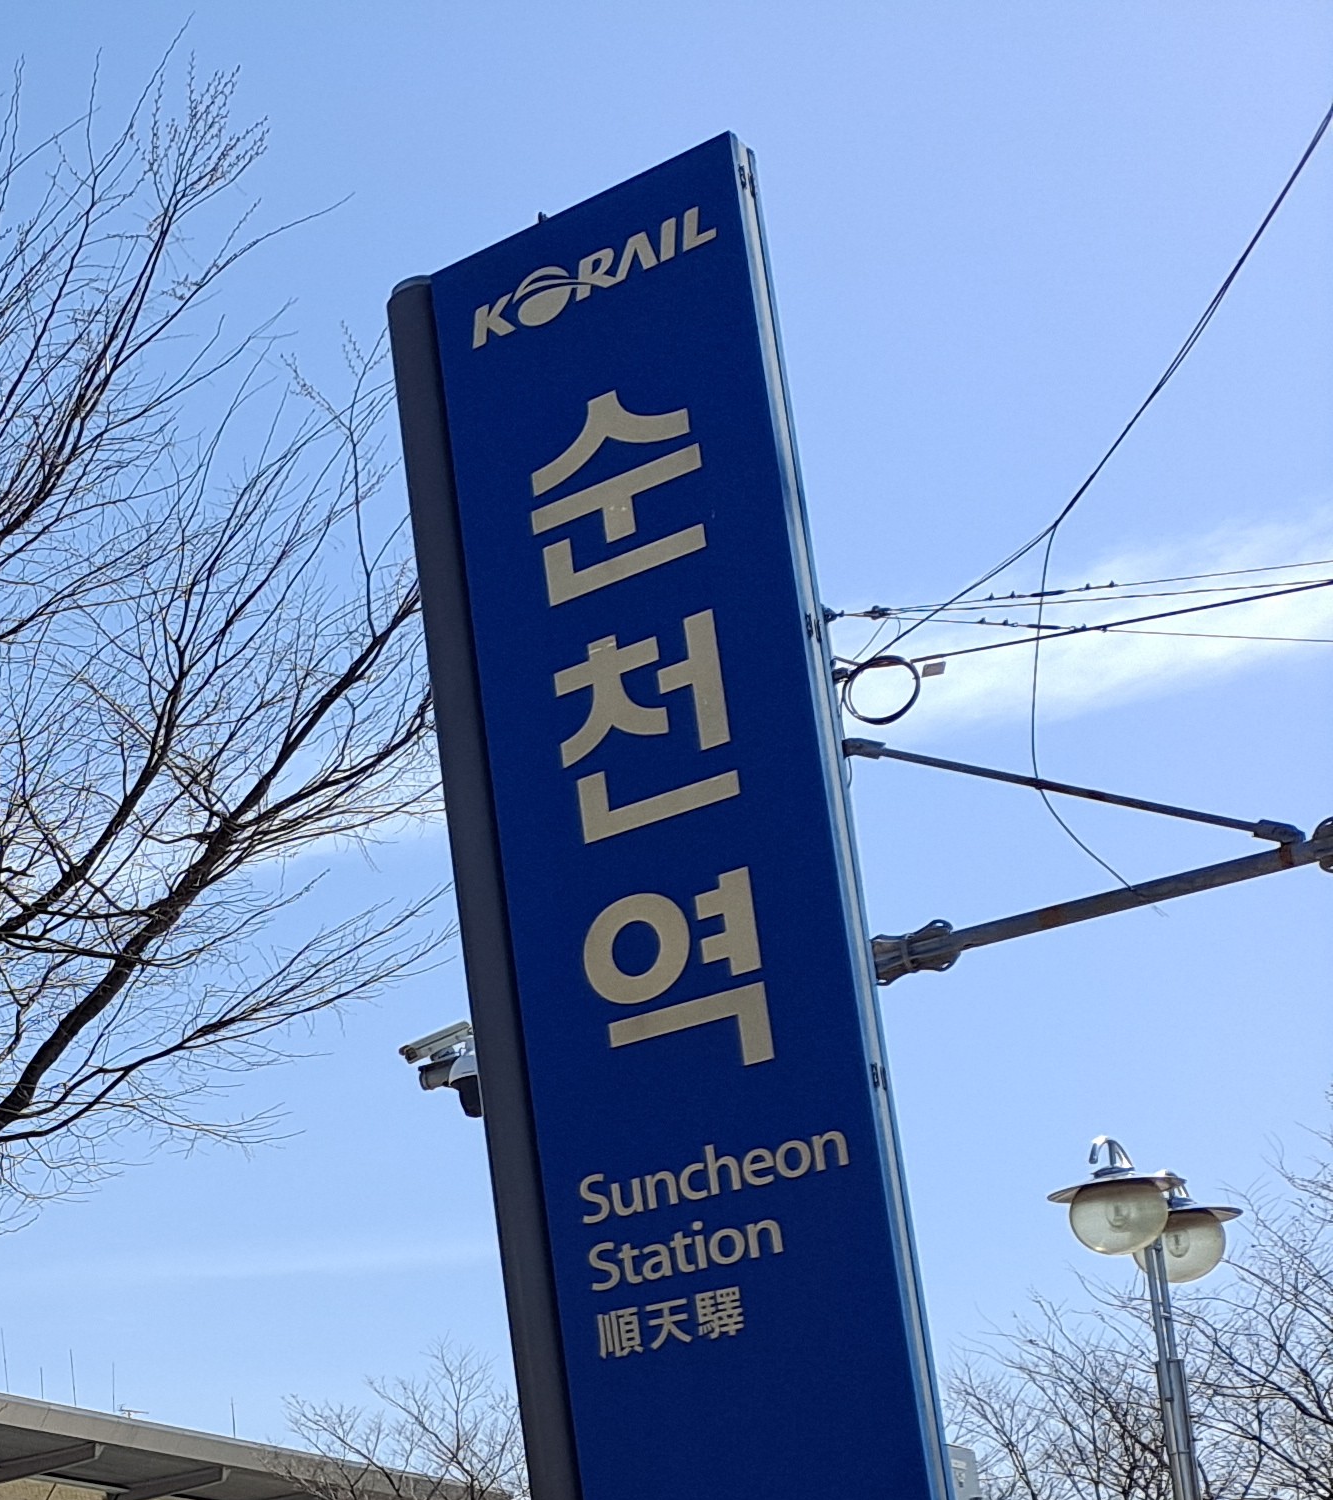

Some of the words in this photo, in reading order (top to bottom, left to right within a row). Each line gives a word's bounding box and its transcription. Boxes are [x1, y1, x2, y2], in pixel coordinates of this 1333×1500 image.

[471, 205, 717, 350] KORAIL
[530, 389, 775, 1067] 순천역
[578, 1128, 850, 1225] Suncheon
[587, 1218, 784, 1292] Station
[596, 1286, 744, 1360] 順天驛
